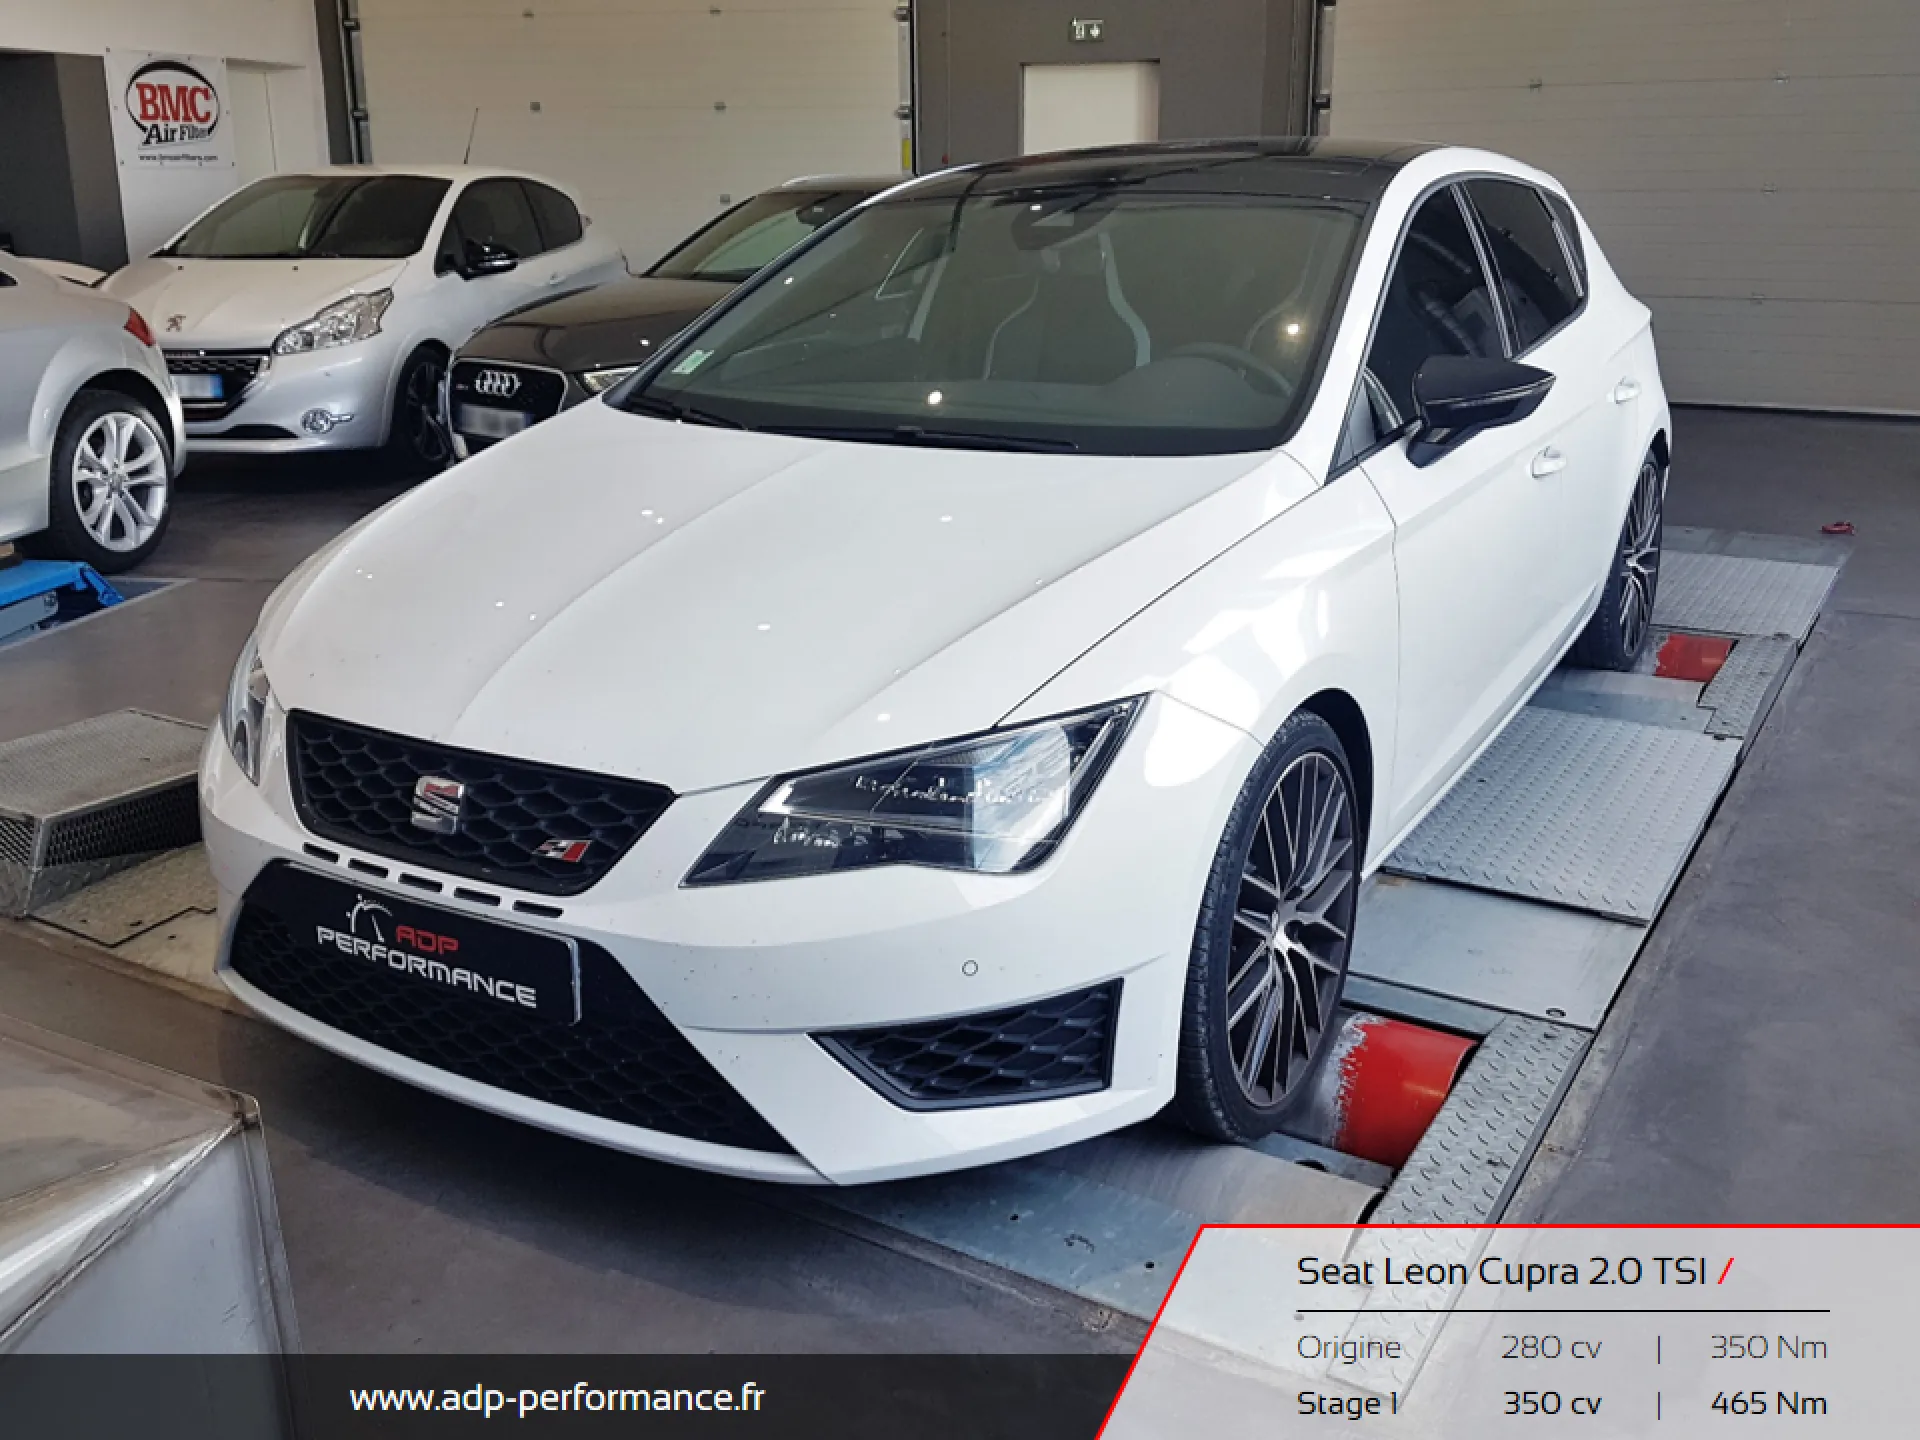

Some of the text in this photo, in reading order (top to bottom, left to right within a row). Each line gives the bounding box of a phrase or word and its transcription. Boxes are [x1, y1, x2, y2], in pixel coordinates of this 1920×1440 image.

[136, 83, 211, 123] BMC
[142, 123, 178, 144] Air
[397, 926, 458, 953] ADP
[317, 926, 537, 1008] PERFORMANCE
